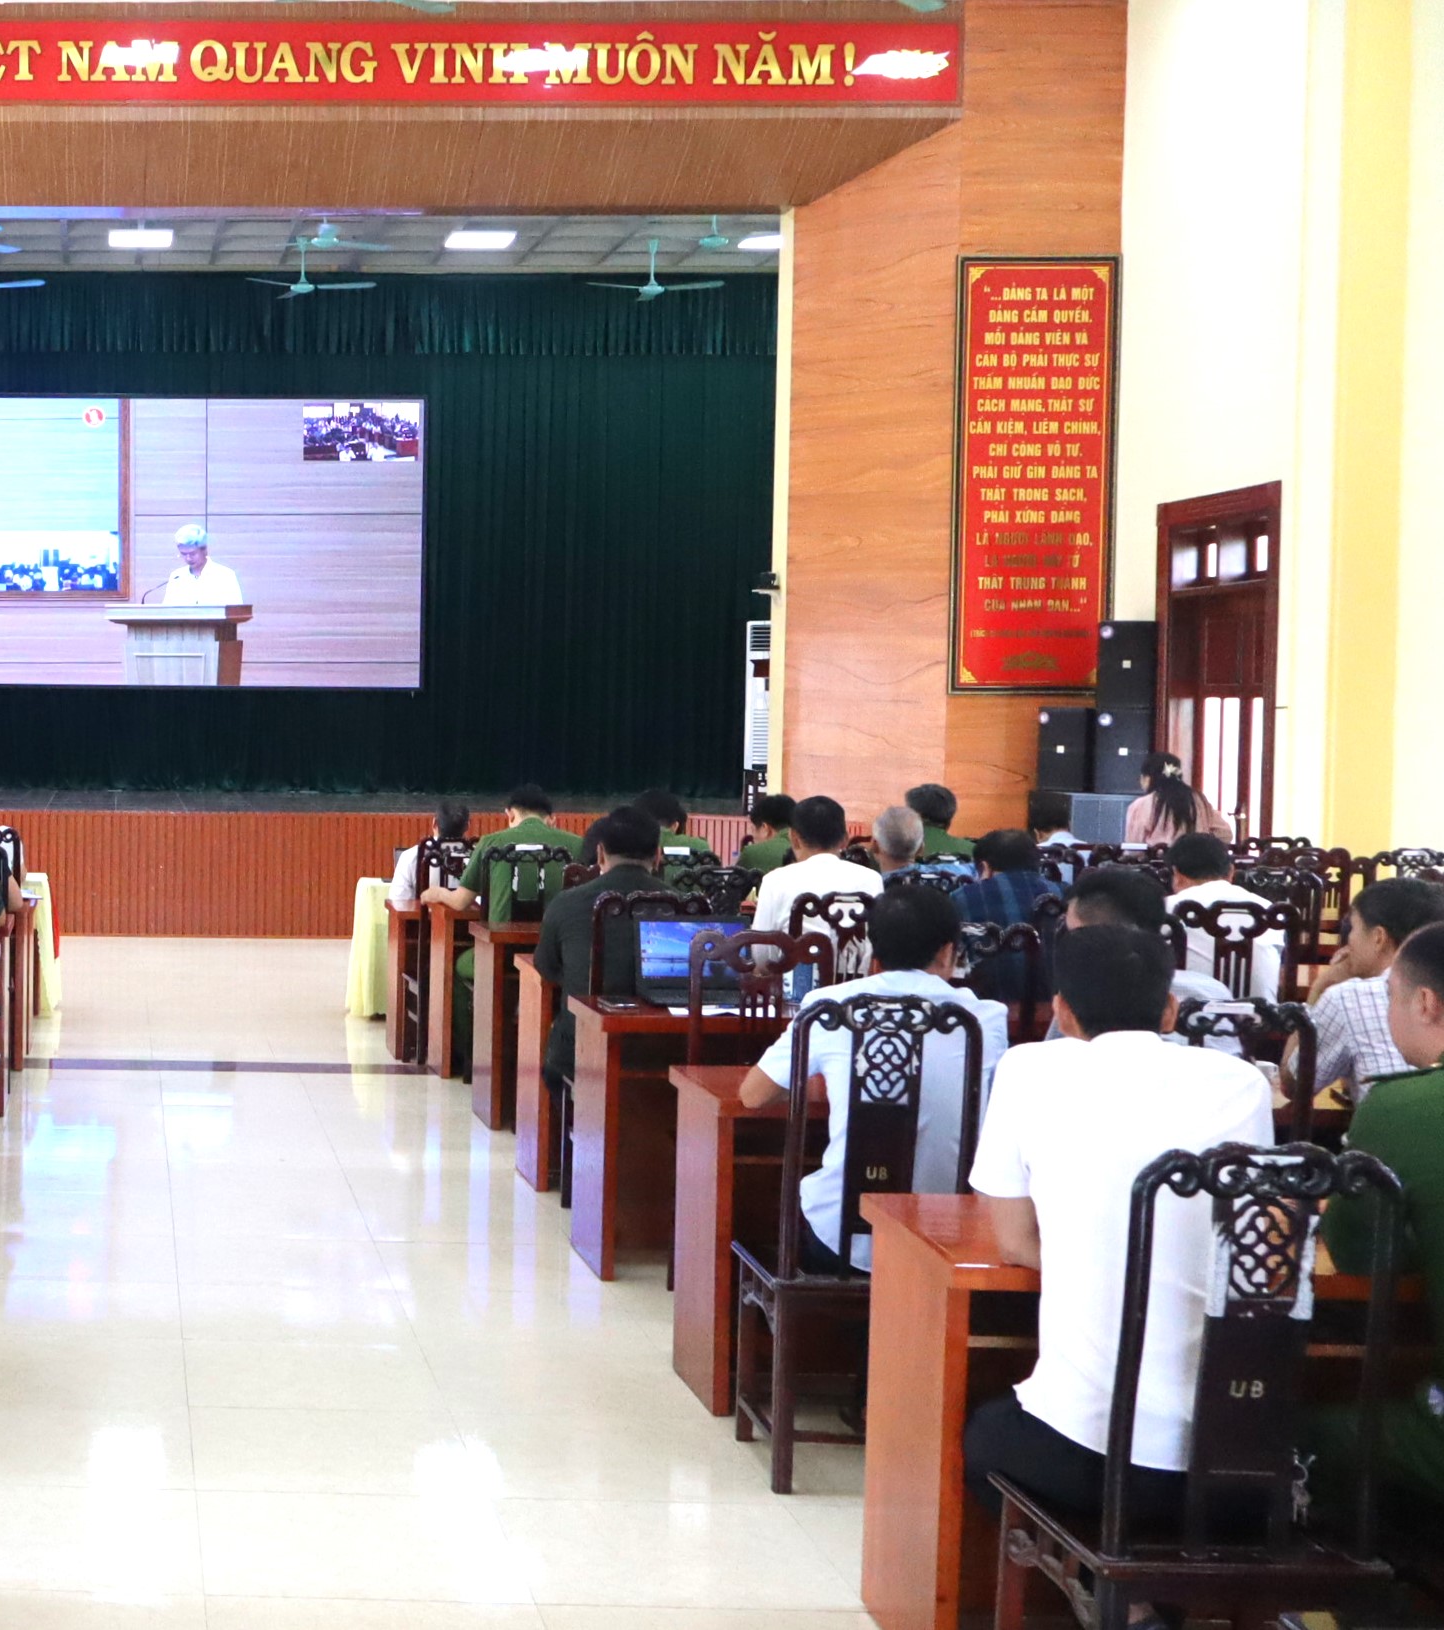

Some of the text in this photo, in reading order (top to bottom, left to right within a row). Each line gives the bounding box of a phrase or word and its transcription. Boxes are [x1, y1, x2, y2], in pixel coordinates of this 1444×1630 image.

[57, 40, 179, 82] NAM
[189, 39, 378, 83] QUANG
[390, 42, 529, 84] VINH
[544, 31, 698, 85] MUÔN
[712, 31, 856, 87] NĂM!
[1036, 288, 1048, 300] TA
[1071, 284, 1094, 304] MỘT
[989, 304, 1018, 322] ĐẢNG
[1010, 327, 1040, 345] ĐẢNG
[1045, 329, 1070, 344] VIÊN
[1003, 350, 1016, 370] BỘ
[1023, 348, 1048, 366] PHẢI
[1053, 353, 1079, 371] THỰC
[1084, 353, 1100, 371] SỰ
[1051, 377, 1072, 393] ĐẠO
[977, 395, 1005, 412] CÁCH
[1079, 398, 1094, 415] SỰ
[1012, 441, 1041, 456] CÔNG
[1047, 440, 1061, 456] VÔ
[973, 460, 997, 478] PHẢI
[1051, 460, 1081, 478] ĐẢNG
[1086, 466, 1098, 478] TA
[1013, 488, 1049, 501] TRONG
[984, 504, 1009, 523] PHẢI
[1010, 577, 1045, 589] TRUNG
[866, 1166, 888, 1180] UB
[1229, 1380, 1264, 1398] UB
